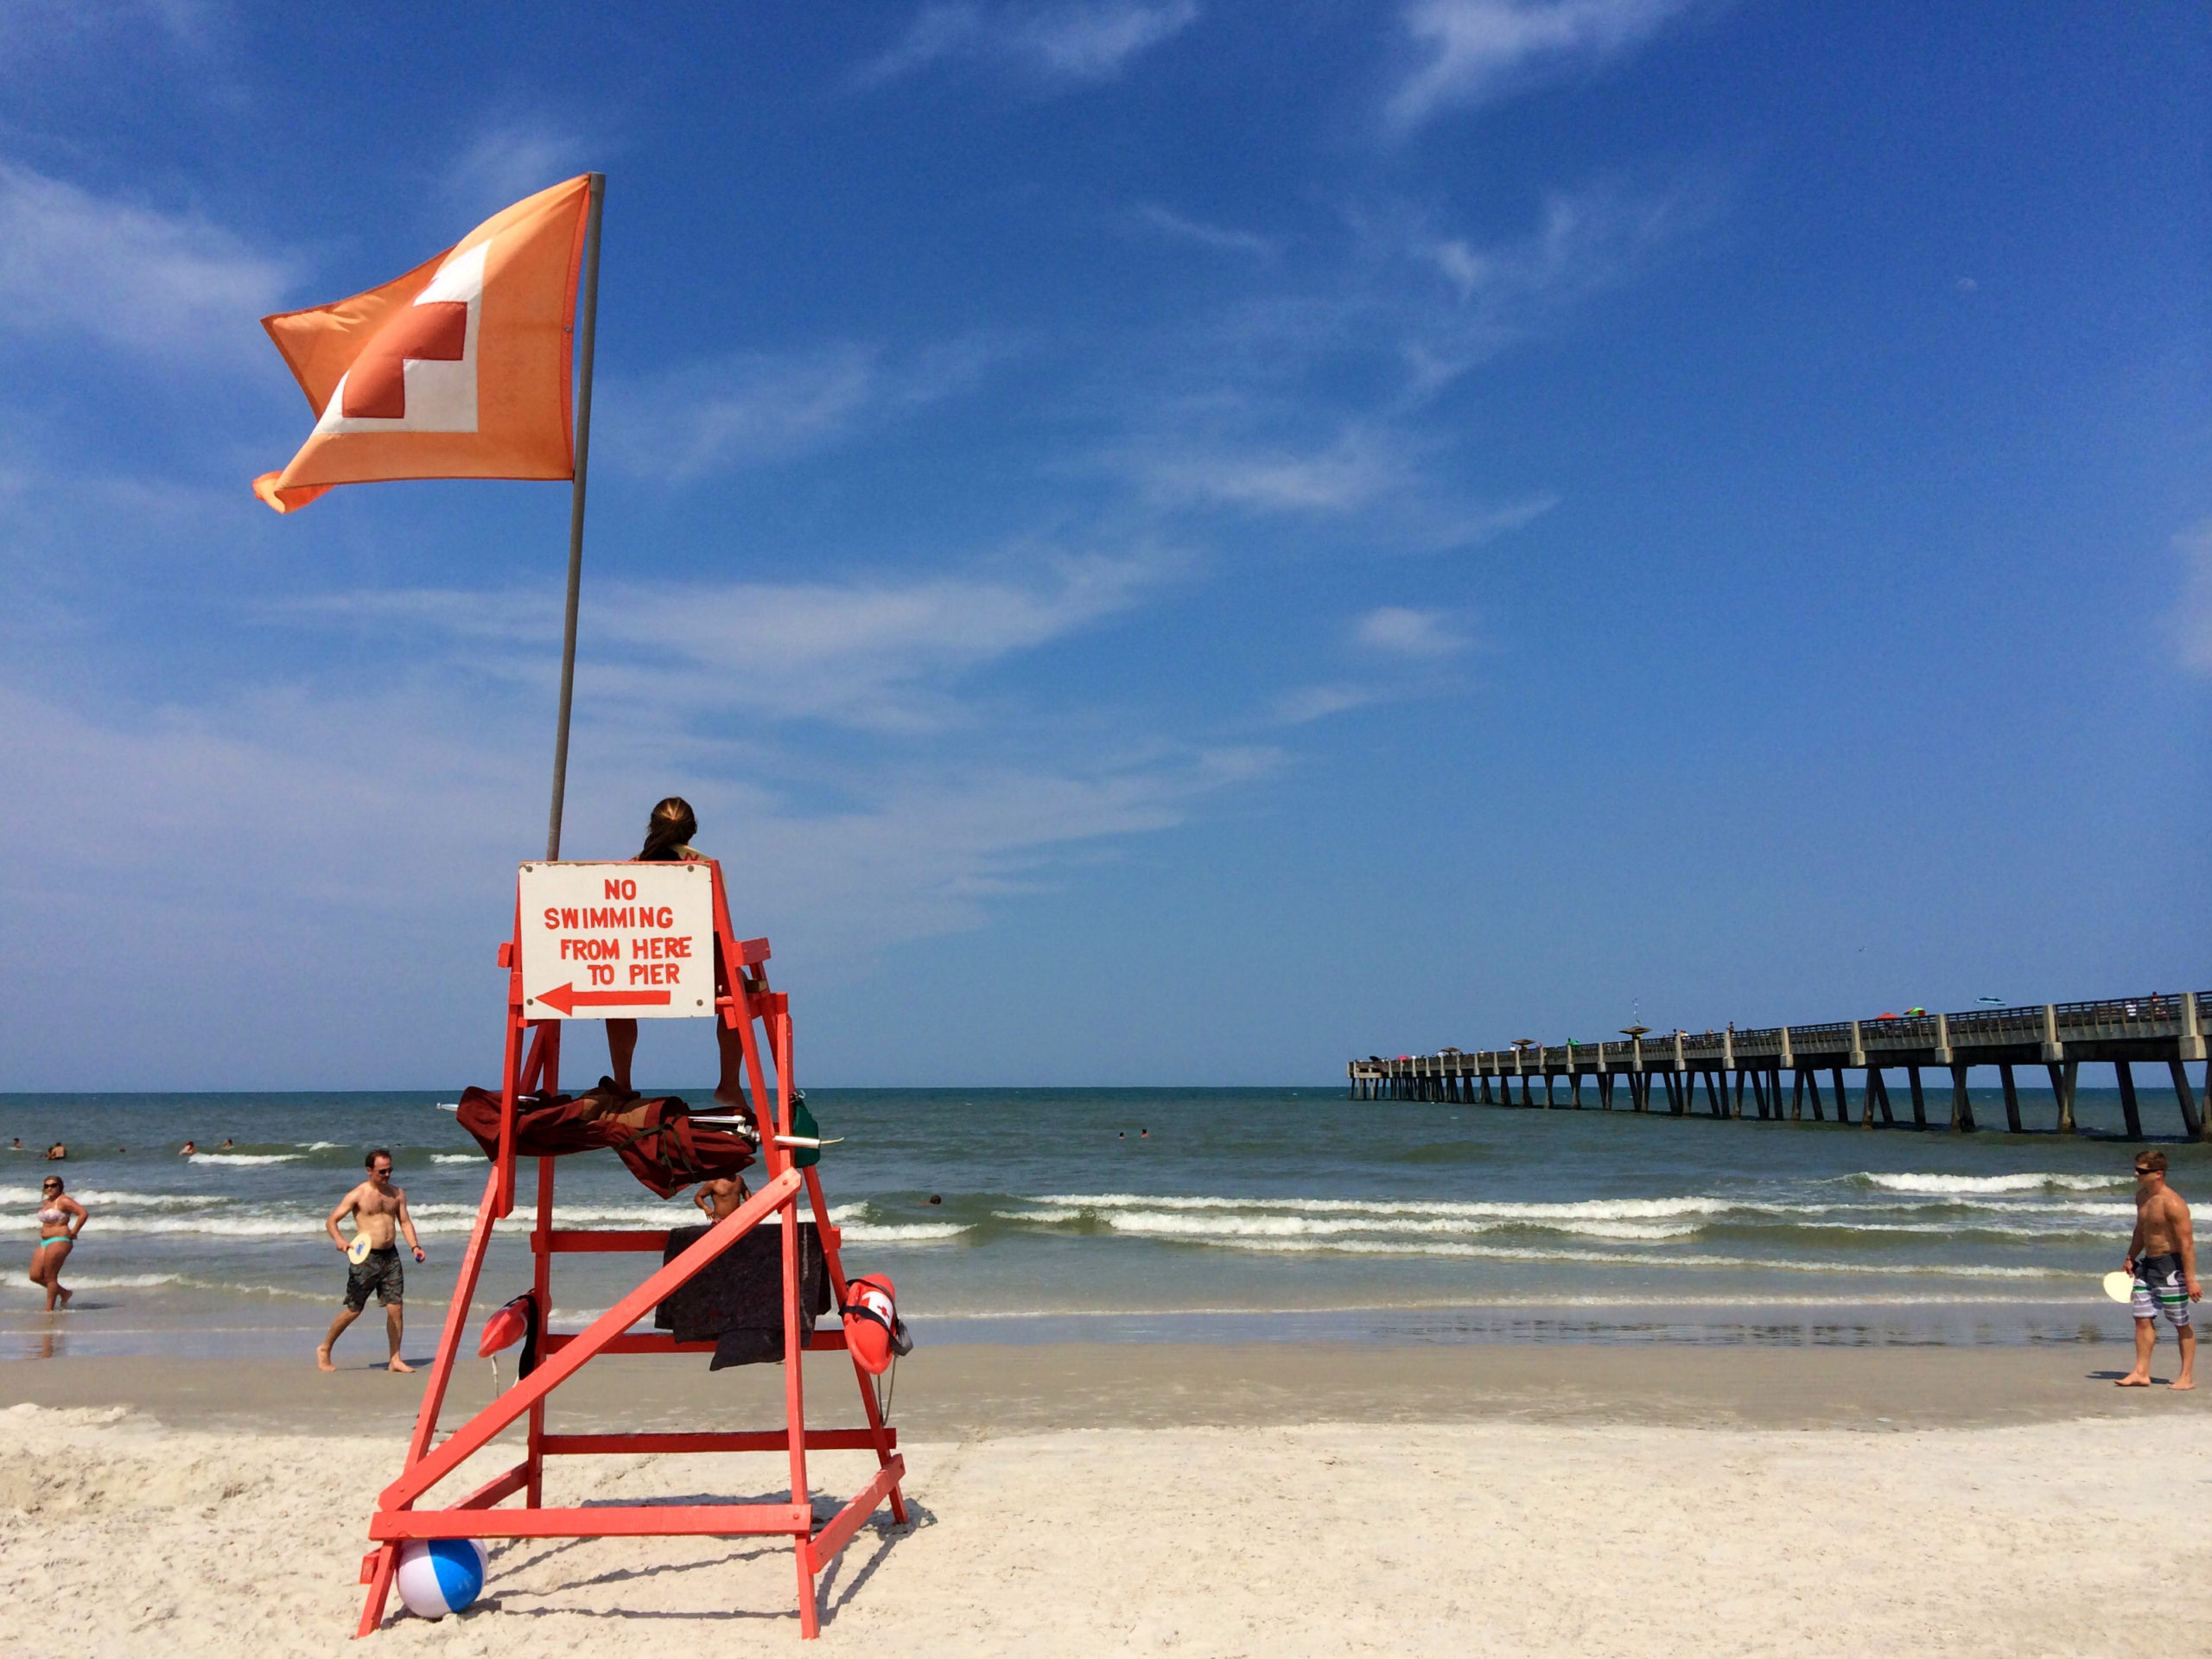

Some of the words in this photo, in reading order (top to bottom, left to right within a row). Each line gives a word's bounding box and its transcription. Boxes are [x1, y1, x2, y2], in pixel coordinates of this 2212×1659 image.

[604, 879, 637, 900] NO
[544, 906, 674, 930] SWIMMING
[560, 938, 620, 961] FROM
[632, 937, 693, 960] HERE
[587, 963, 615, 986] TO
[629, 963, 681, 986] PIER
